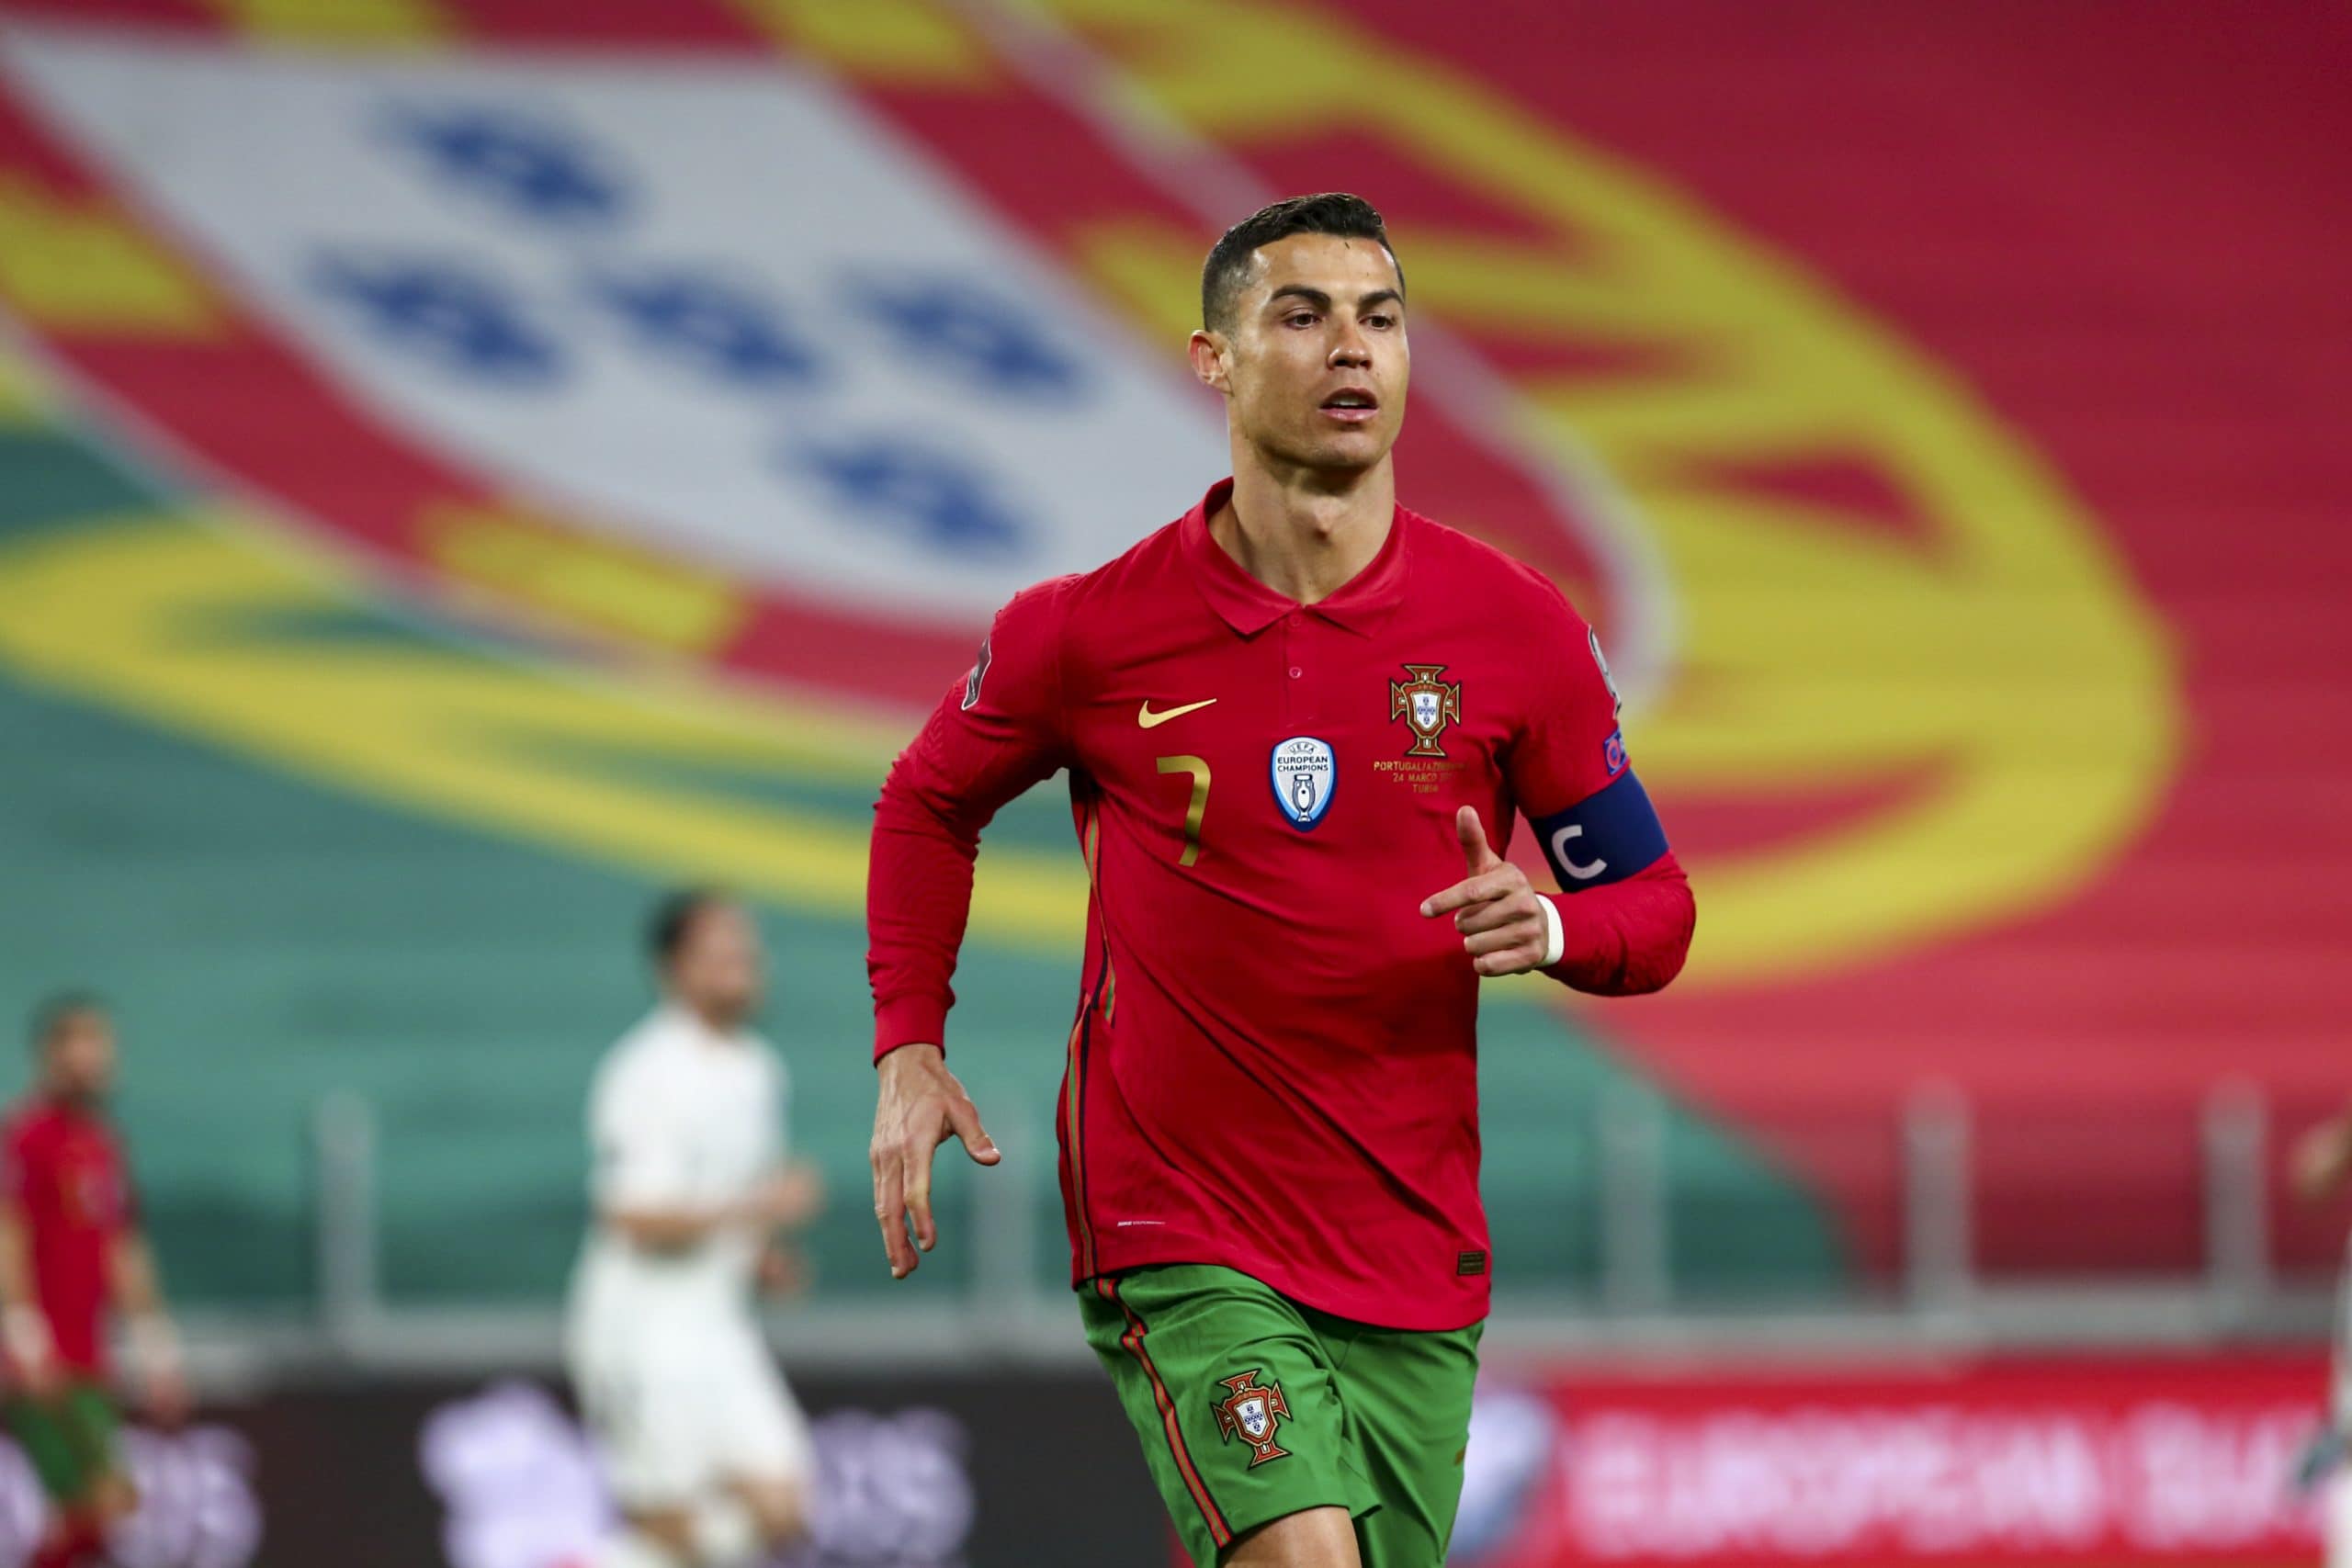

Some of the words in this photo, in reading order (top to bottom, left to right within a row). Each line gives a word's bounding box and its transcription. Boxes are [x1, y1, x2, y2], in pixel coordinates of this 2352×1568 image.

[1289, 743, 1315, 753] UEFA
[1277, 756, 1329, 764] EUROPEAN
[1277, 764, 1329, 773] CHAMPIONS
[1392, 773, 1404, 783] 24
[1156, 755, 1212, 867] 7
[1552, 824, 1608, 880] C
